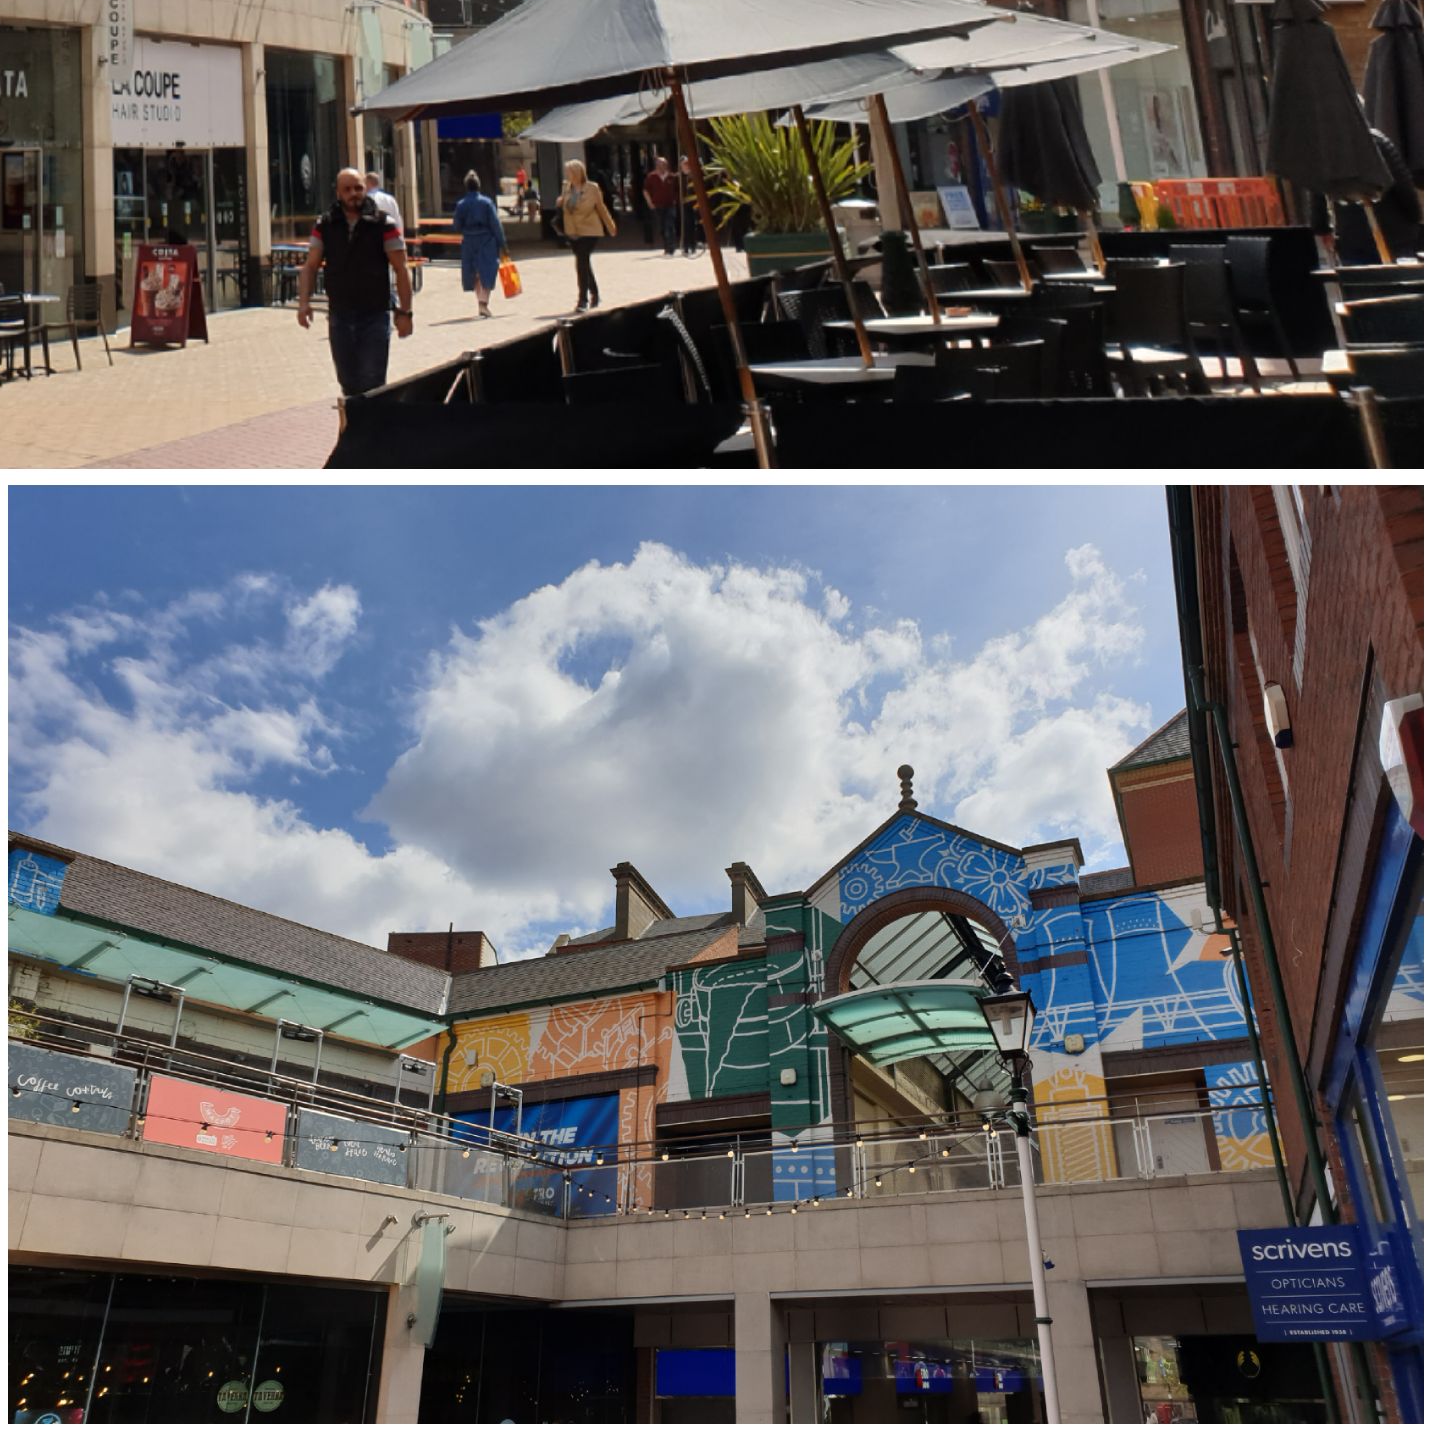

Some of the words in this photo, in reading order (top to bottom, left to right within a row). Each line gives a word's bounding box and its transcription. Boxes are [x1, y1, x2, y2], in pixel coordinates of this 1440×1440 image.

[134, 70, 181, 100] COUPE
[112, 103, 139, 121] HAIR
[143, 104, 182, 123] STUDIO
[152, 248, 179, 257] COSTA
[17, 1073, 59, 1093] Coffee
[540, 1126, 578, 1146] THE
[1252, 1238, 1352, 1261] scrivens
[1271, 1276, 1346, 1290] OPTICIANS
[1261, 1303, 1325, 1316] HEARING
[1328, 1302, 1366, 1314] CARE
